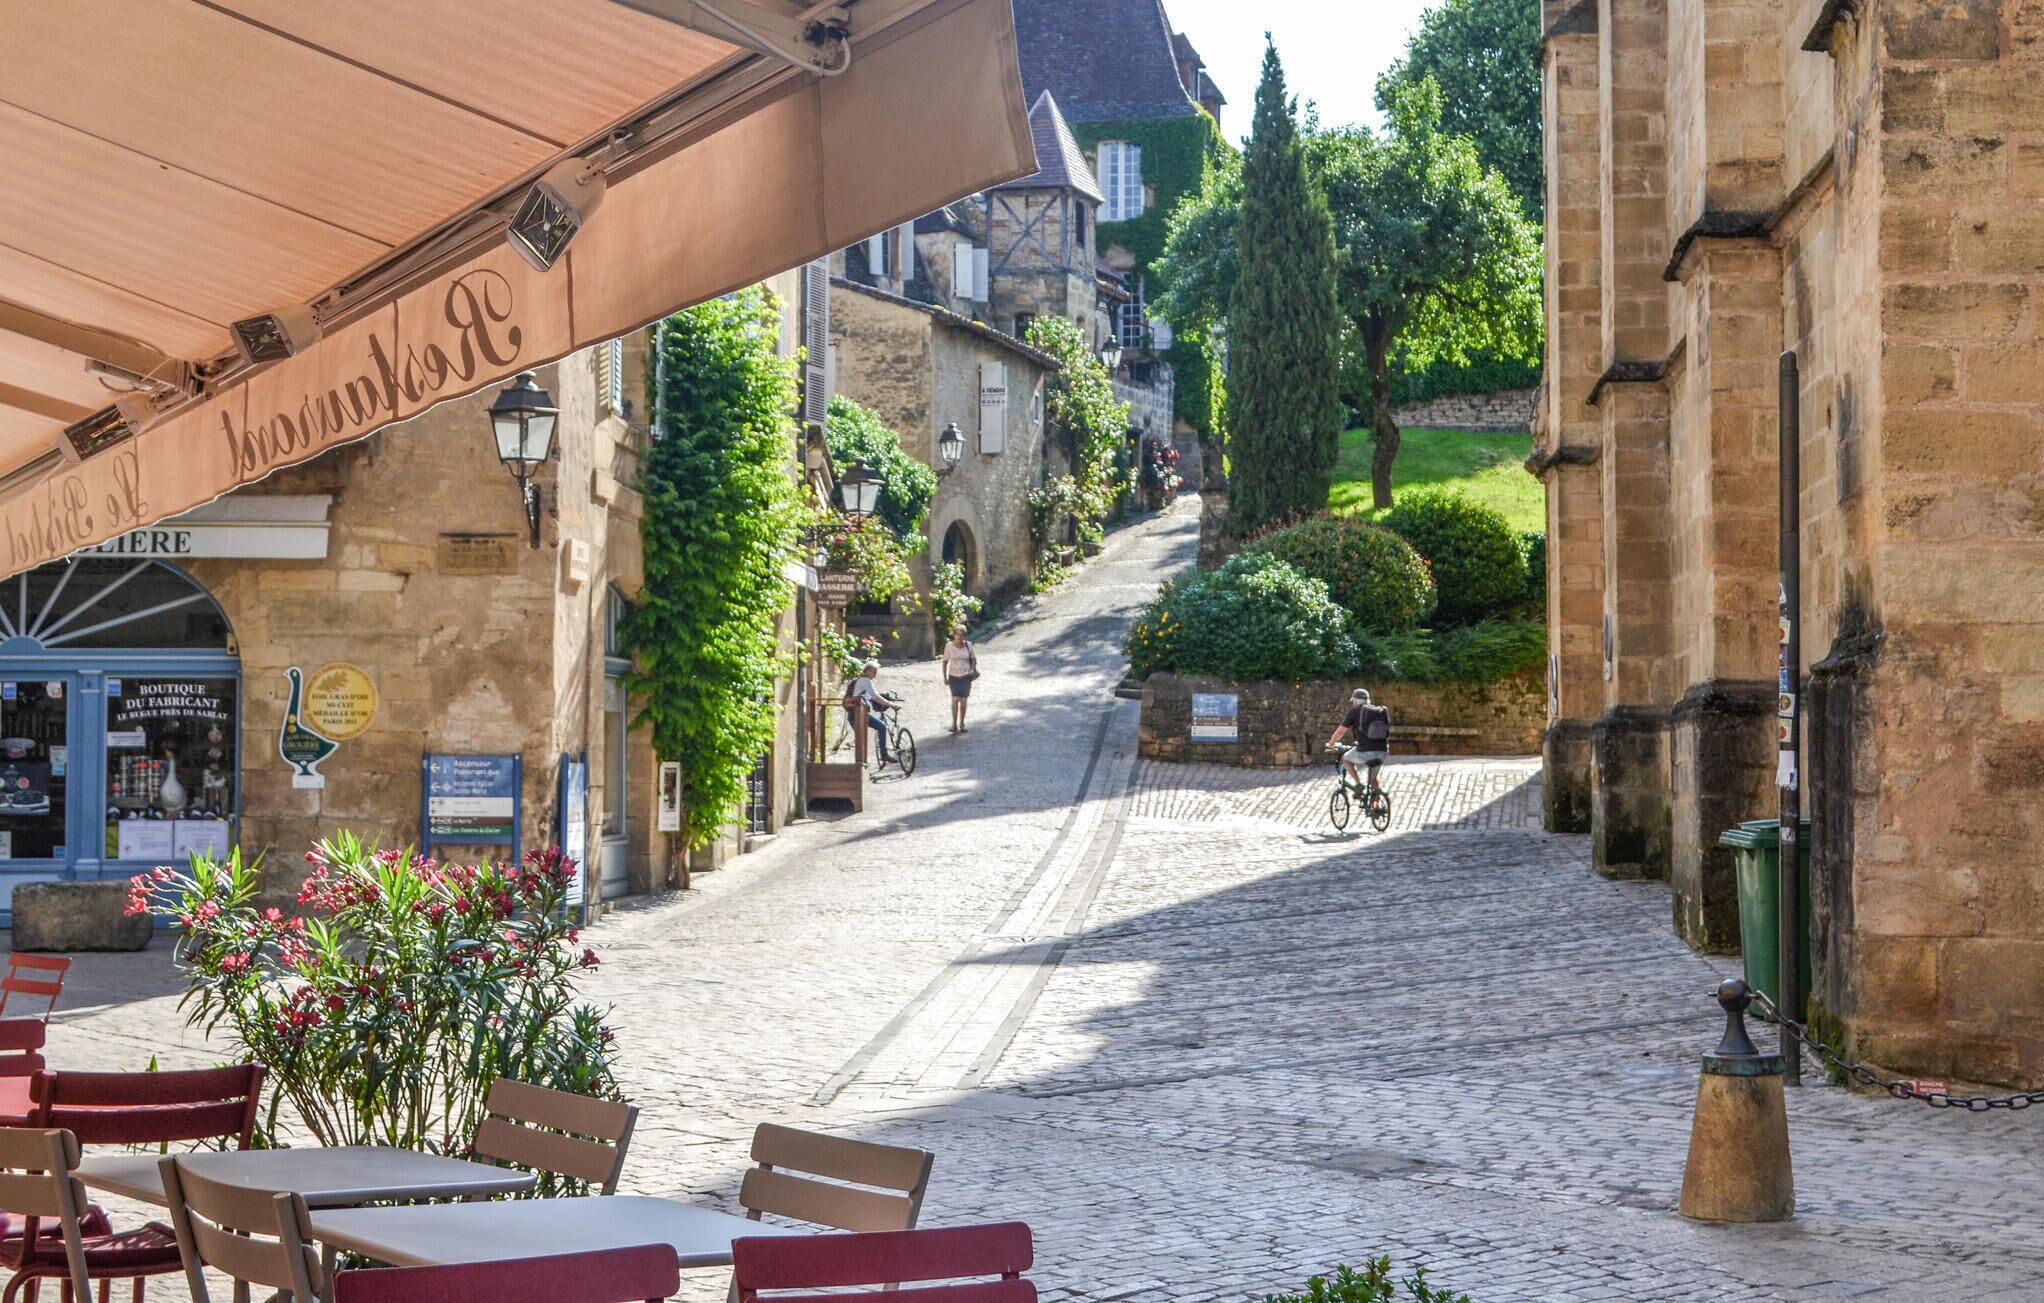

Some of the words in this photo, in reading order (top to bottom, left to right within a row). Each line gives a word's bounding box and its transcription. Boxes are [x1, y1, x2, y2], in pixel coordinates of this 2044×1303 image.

[79, 530, 192, 553] LIERE
[139, 683, 206, 696] BOUTIQUE
[126, 698, 145, 709] DU
[148, 696, 220, 708] FABRICANT
[117, 712, 127, 721] LE
[129, 709, 158, 719] BUGUE
[183, 708, 194, 716] DE
[196, 709, 228, 720] SARLAT
[453, 760, 492, 768] Ascenseur
